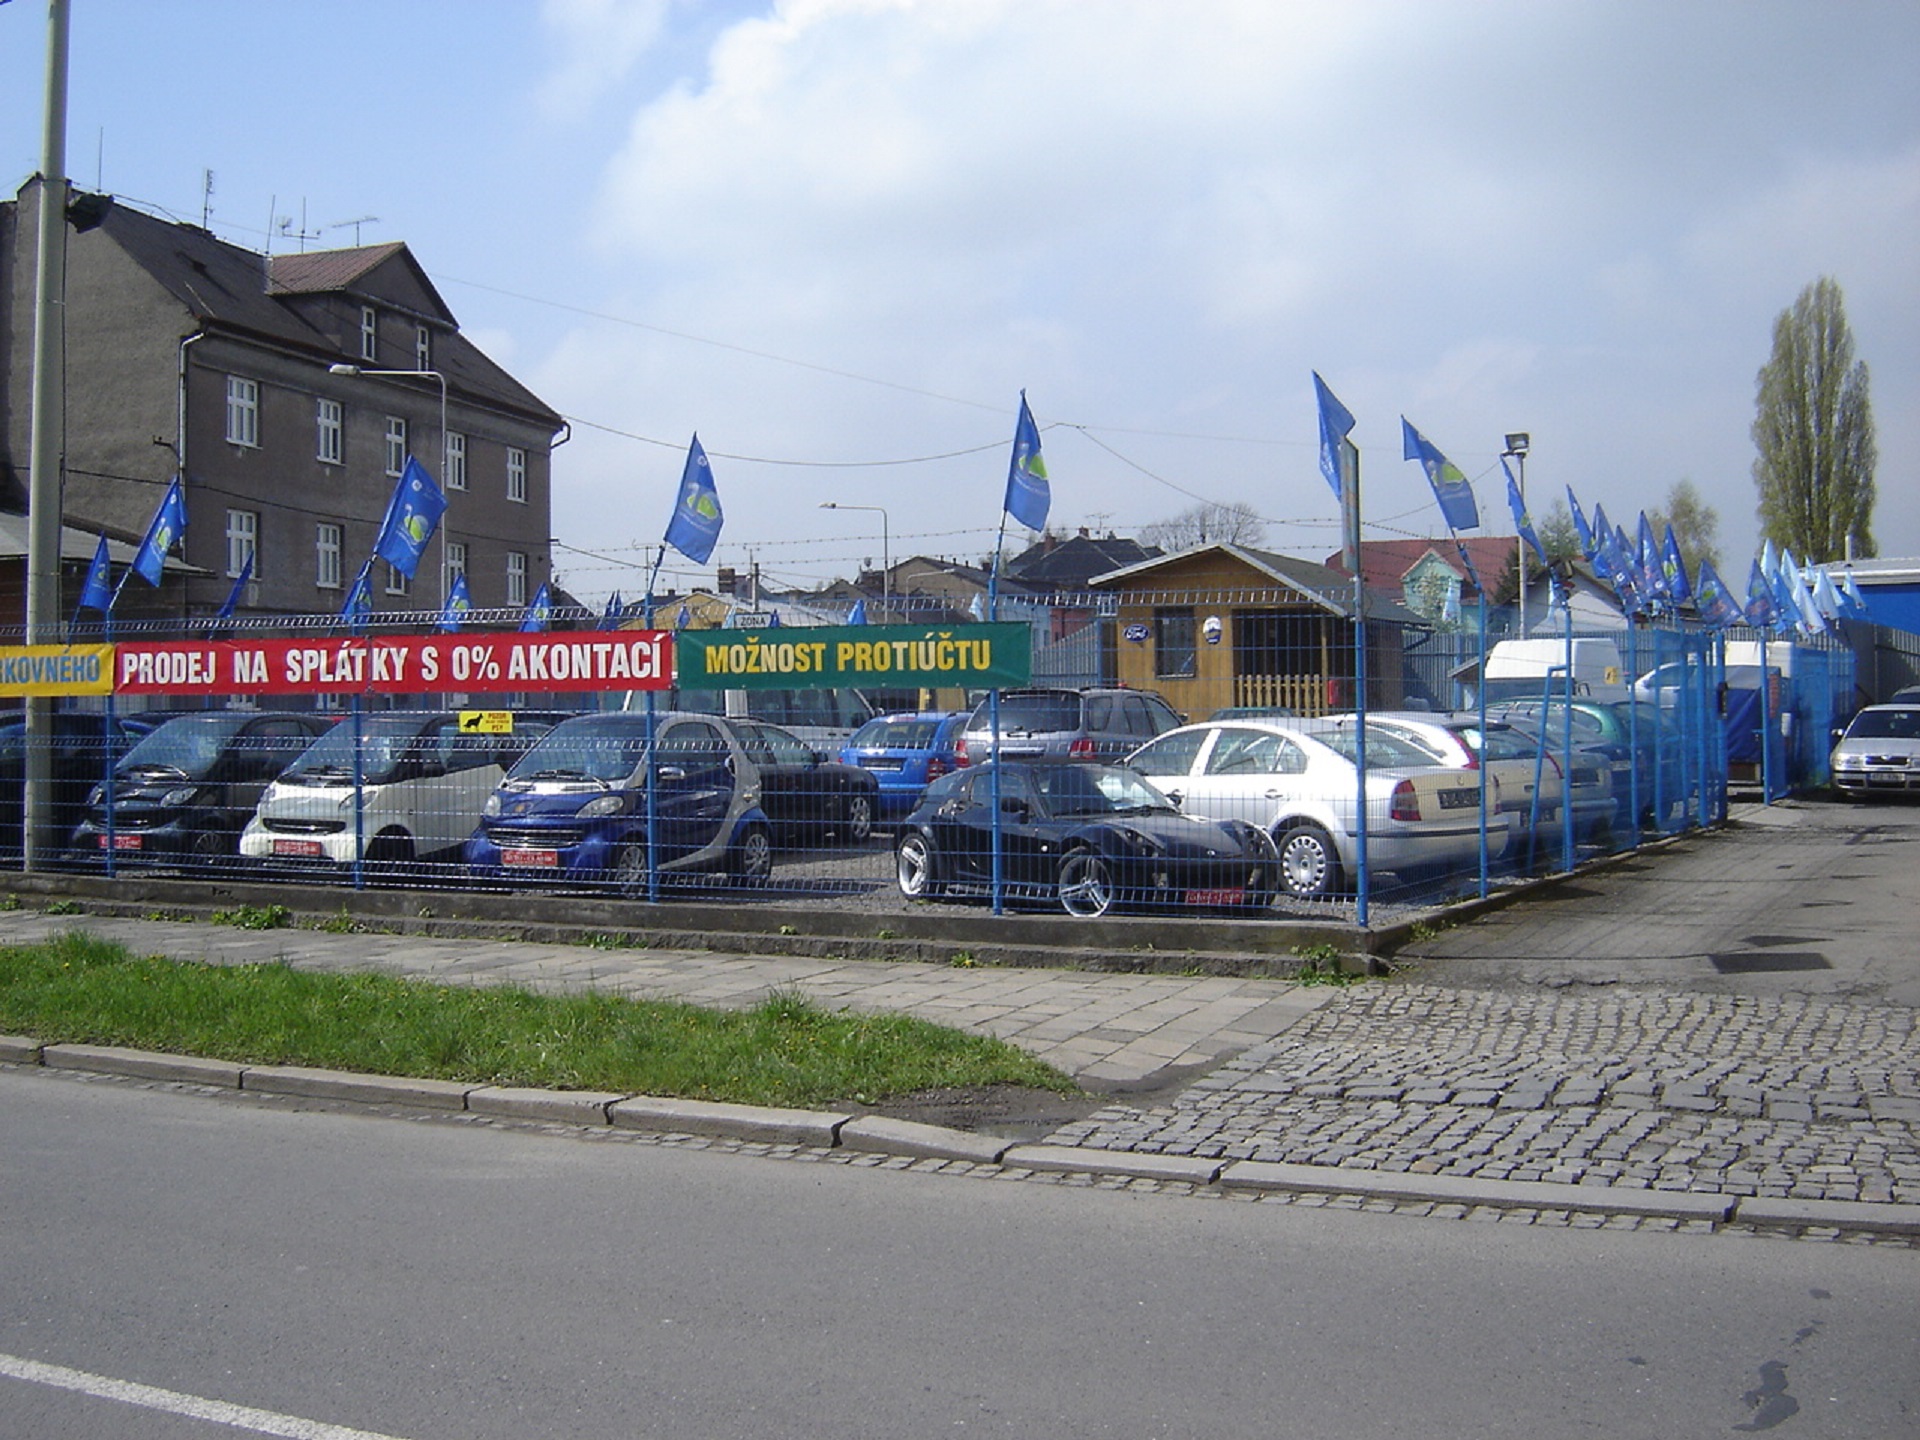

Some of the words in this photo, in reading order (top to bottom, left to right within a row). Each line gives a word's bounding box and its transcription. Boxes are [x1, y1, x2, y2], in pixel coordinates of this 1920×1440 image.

[740, 616, 766, 627] ZONA
[0, 646, 100, 684] KOVNÉHO
[123, 650, 216, 684] PRODEJ
[234, 650, 269, 683] NA
[286, 640, 409, 683] SPLÁTKY
[421, 646, 440, 681] S
[452, 645, 500, 680] 0%
[508, 632, 666, 680] AKONTACÍ
[705, 636, 827, 674] MOŽNOST
[837, 632, 991, 672] PROTIÚČTU
